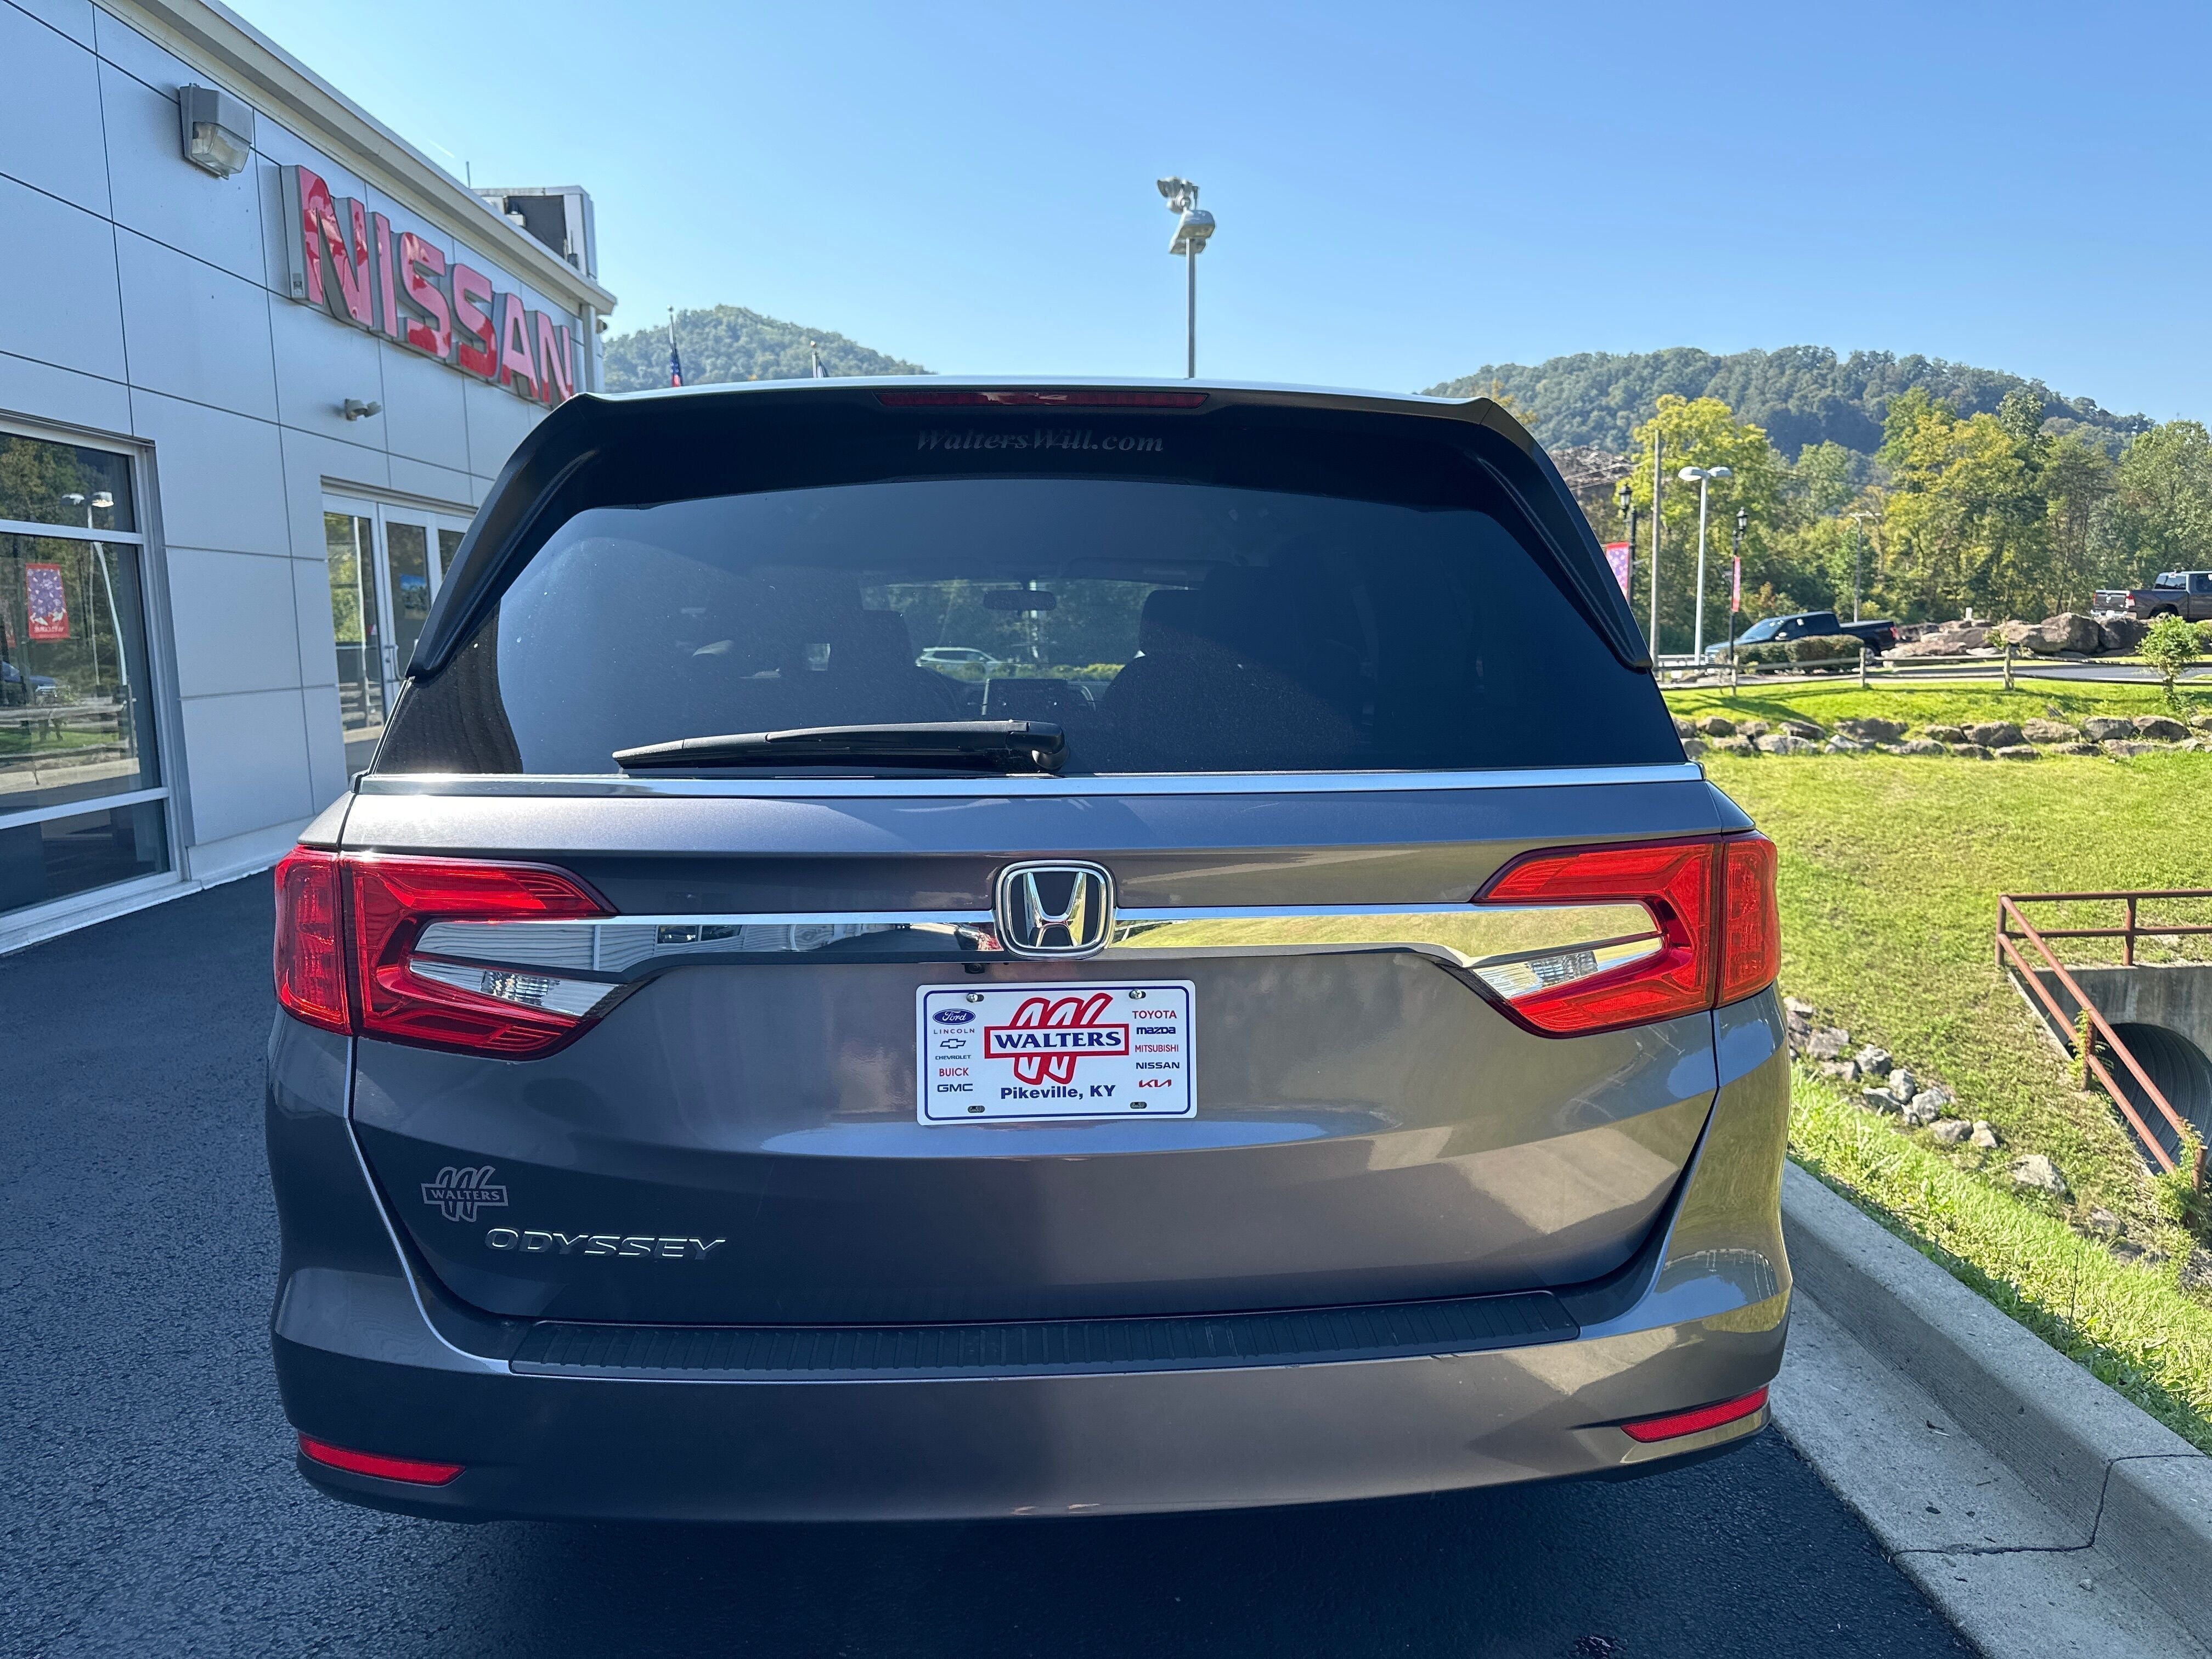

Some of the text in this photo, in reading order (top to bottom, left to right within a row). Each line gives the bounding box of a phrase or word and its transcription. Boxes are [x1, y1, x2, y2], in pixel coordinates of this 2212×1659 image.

[298, 165, 574, 403] NISSAN
[917, 428, 1164, 452] WaltersWill.com
[941, 1011, 967, 1022] Ford
[1132, 1010, 1177, 1019] TOYOTA
[1136, 1026, 1176, 1035] mazda
[994, 1031, 1121, 1049] WALTERS
[1135, 1044, 1179, 1053] MITSUBISHI
[939, 1067, 969, 1077] BUICK
[937, 1083, 973, 1092] GMC
[1001, 1085, 1116, 1100] Pikeville, KY
[430, 1188, 501, 1202] WALTERS
[485, 1227, 726, 1260] ODYSSEY
